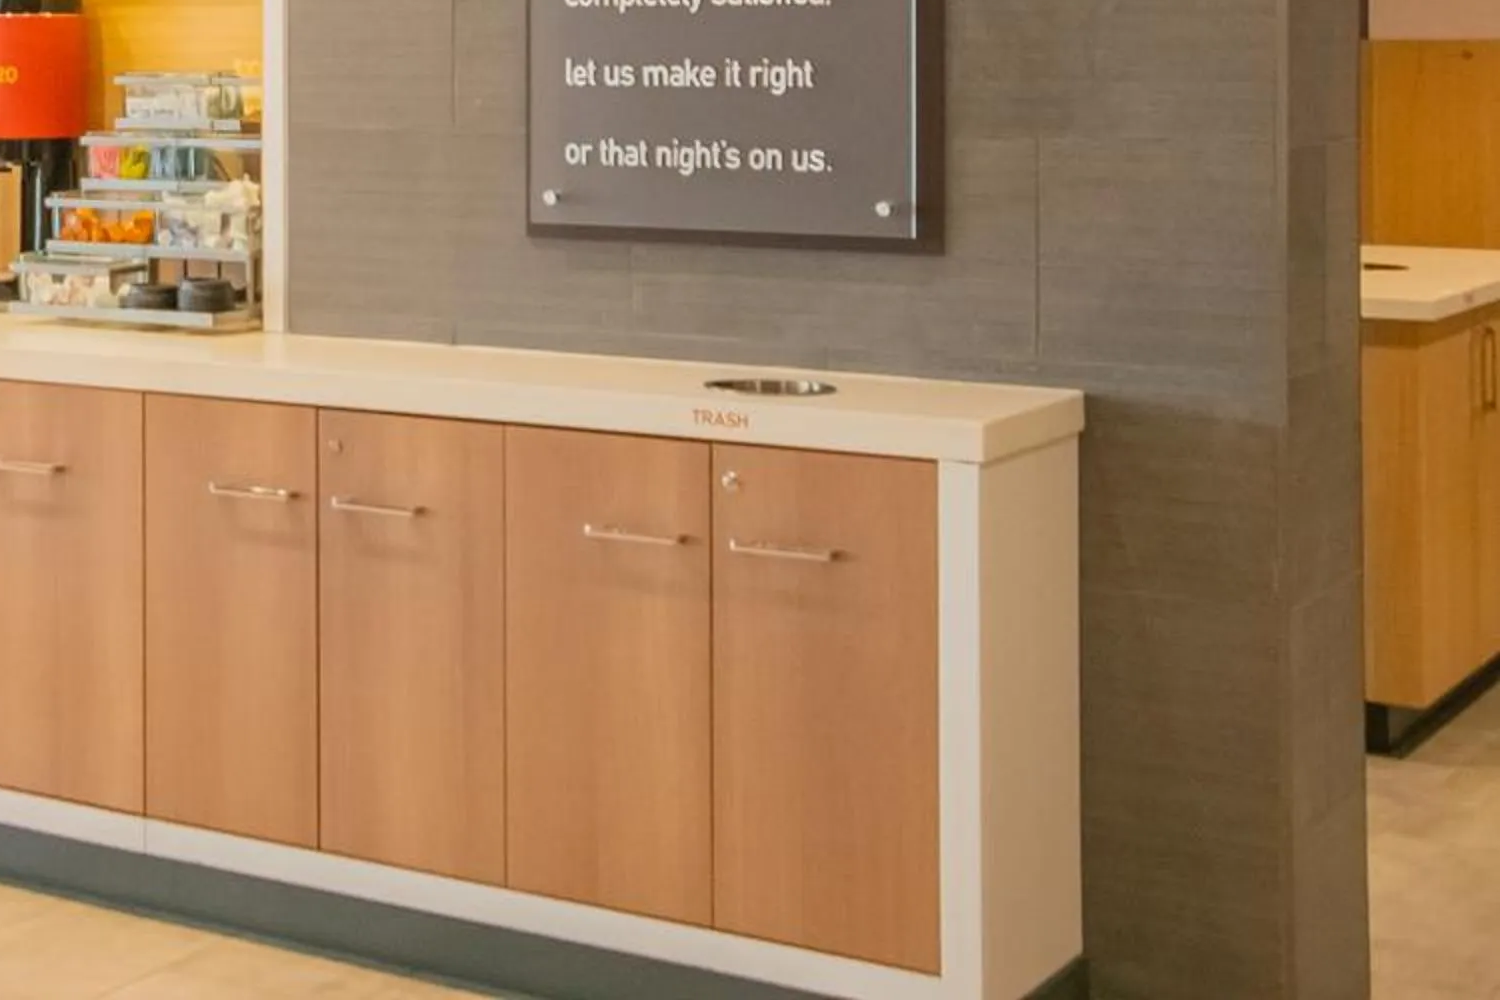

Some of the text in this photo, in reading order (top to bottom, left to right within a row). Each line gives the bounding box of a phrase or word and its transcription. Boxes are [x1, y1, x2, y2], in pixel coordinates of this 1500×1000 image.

[565, 57, 814, 97] let us make it right
[564, 136, 833, 177] or that night's on us.
[692, 408, 750, 429] TRASH
